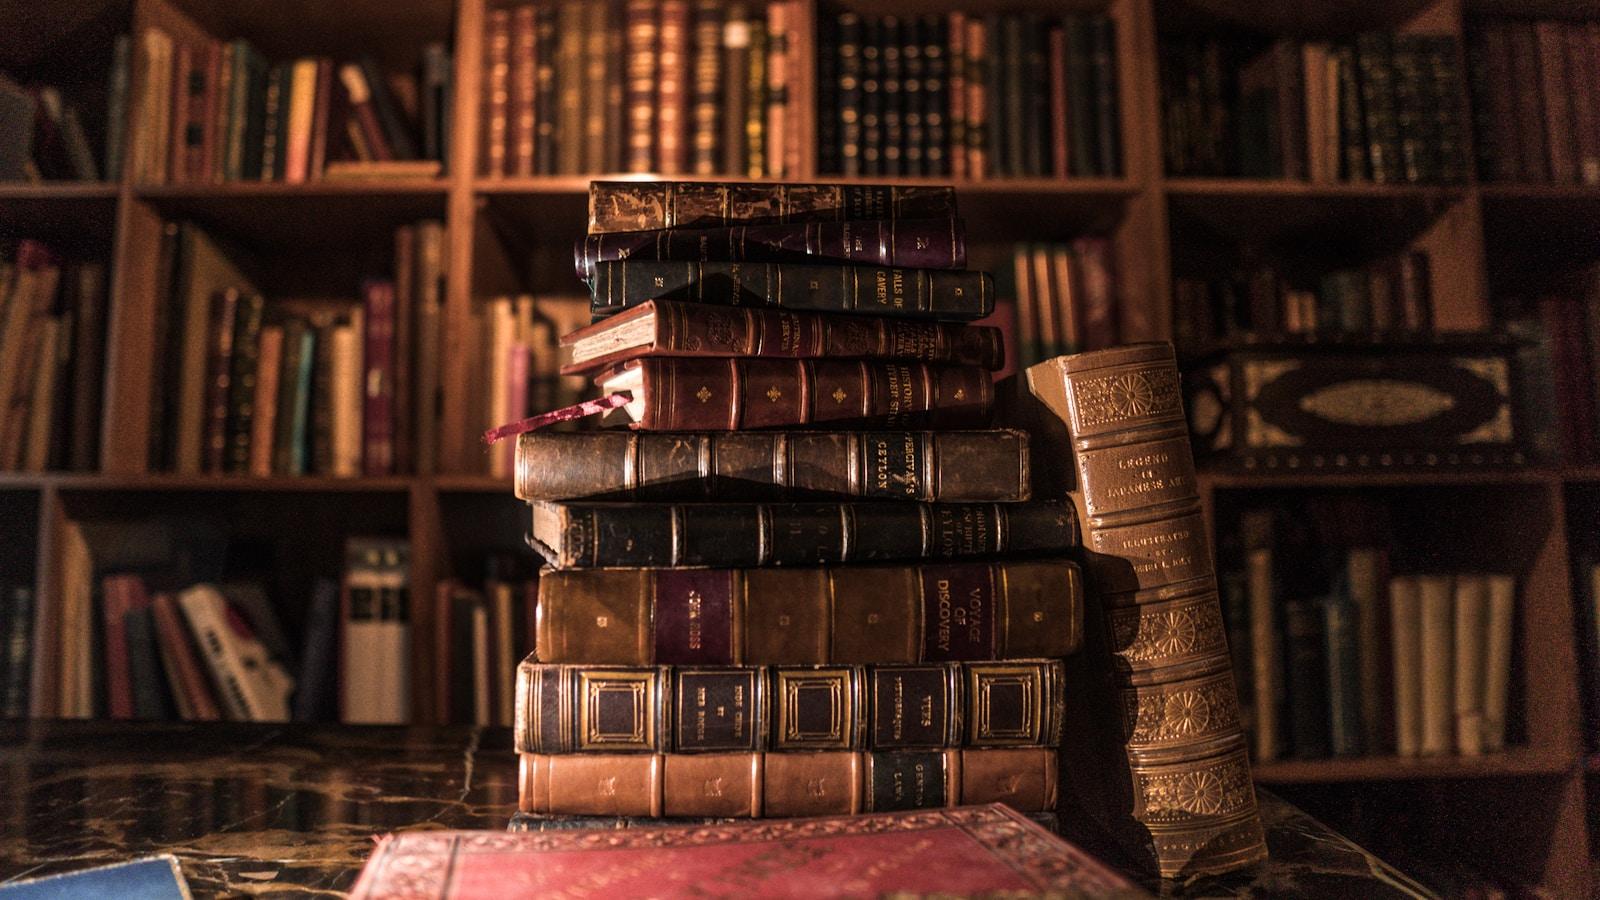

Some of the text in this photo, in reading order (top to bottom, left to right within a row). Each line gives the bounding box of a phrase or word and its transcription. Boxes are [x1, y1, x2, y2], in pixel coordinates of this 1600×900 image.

[876, 271, 887, 305] CAVERY
[893, 269, 903, 309] FALLS OF
[901, 366, 912, 409] HISTORY
[878, 441, 887, 489] CEYLON
[1118, 454, 1169, 470] LEGEND
[1107, 479, 1164, 498] JAPANESE
[936, 579, 950, 652] DISCOVERY
[953, 606, 966, 625] OF
[968, 587, 981, 643] VOYAGE
[688, 623, 701, 650] ROSS
